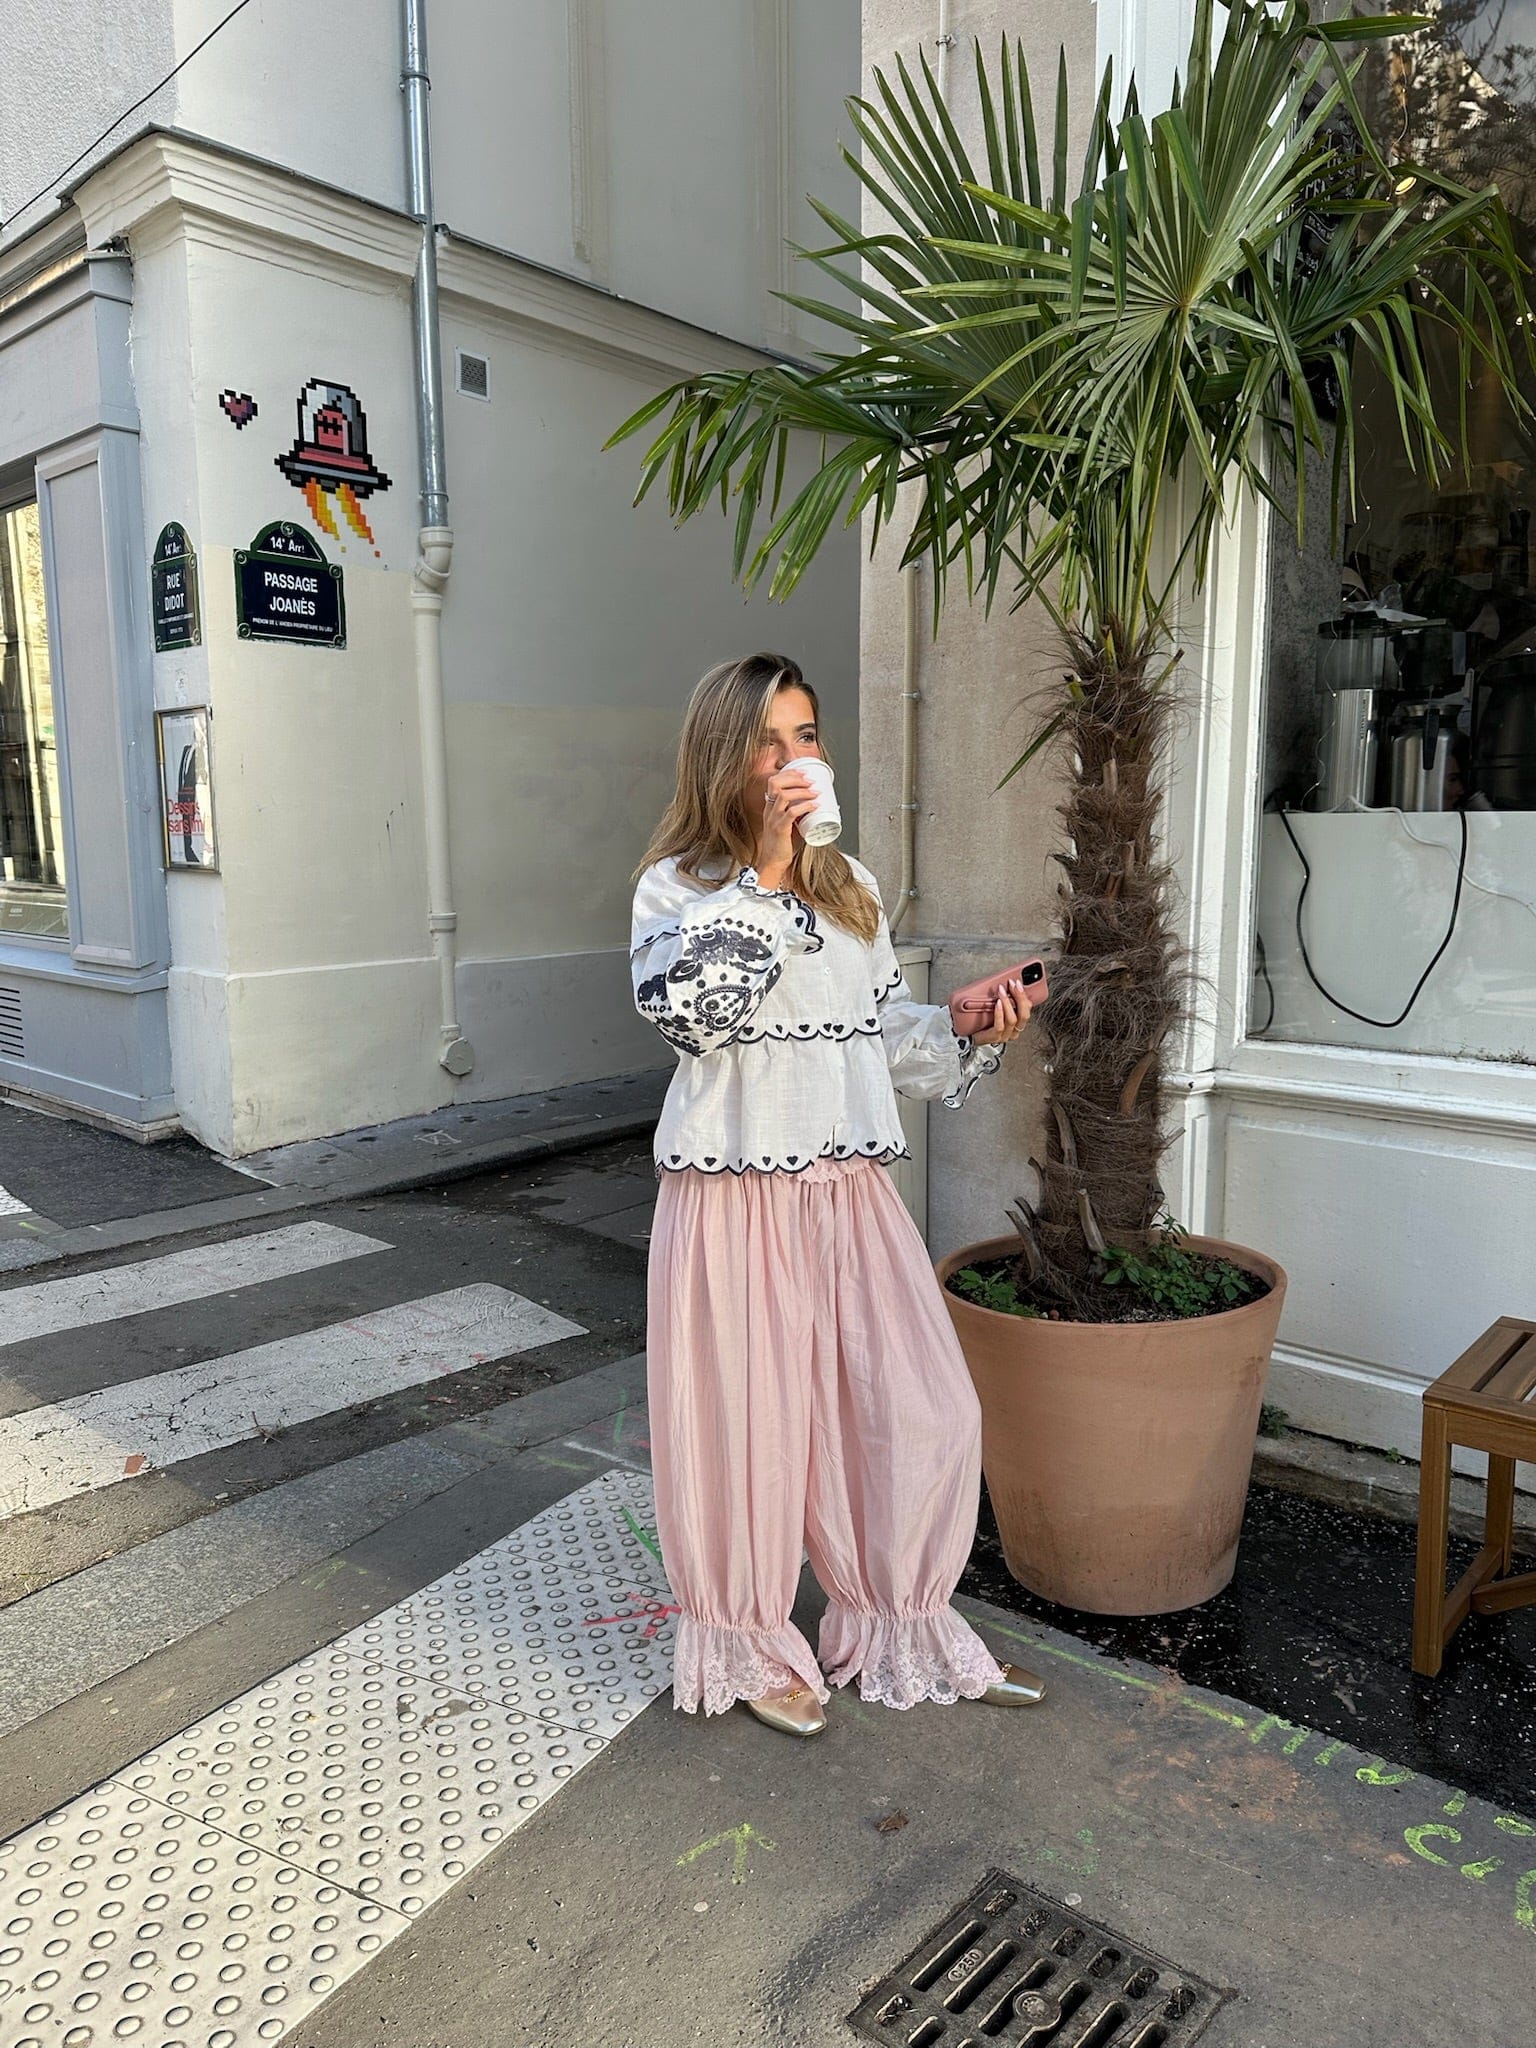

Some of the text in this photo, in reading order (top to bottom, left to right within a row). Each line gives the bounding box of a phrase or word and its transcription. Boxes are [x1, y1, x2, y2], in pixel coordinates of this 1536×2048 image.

[166, 572, 181, 590] RUE
[264, 571, 318, 593] PASSAGE
[164, 593, 184, 612] DIDOT
[167, 799, 200, 815] Dessins
[168, 820, 190, 833] sans
